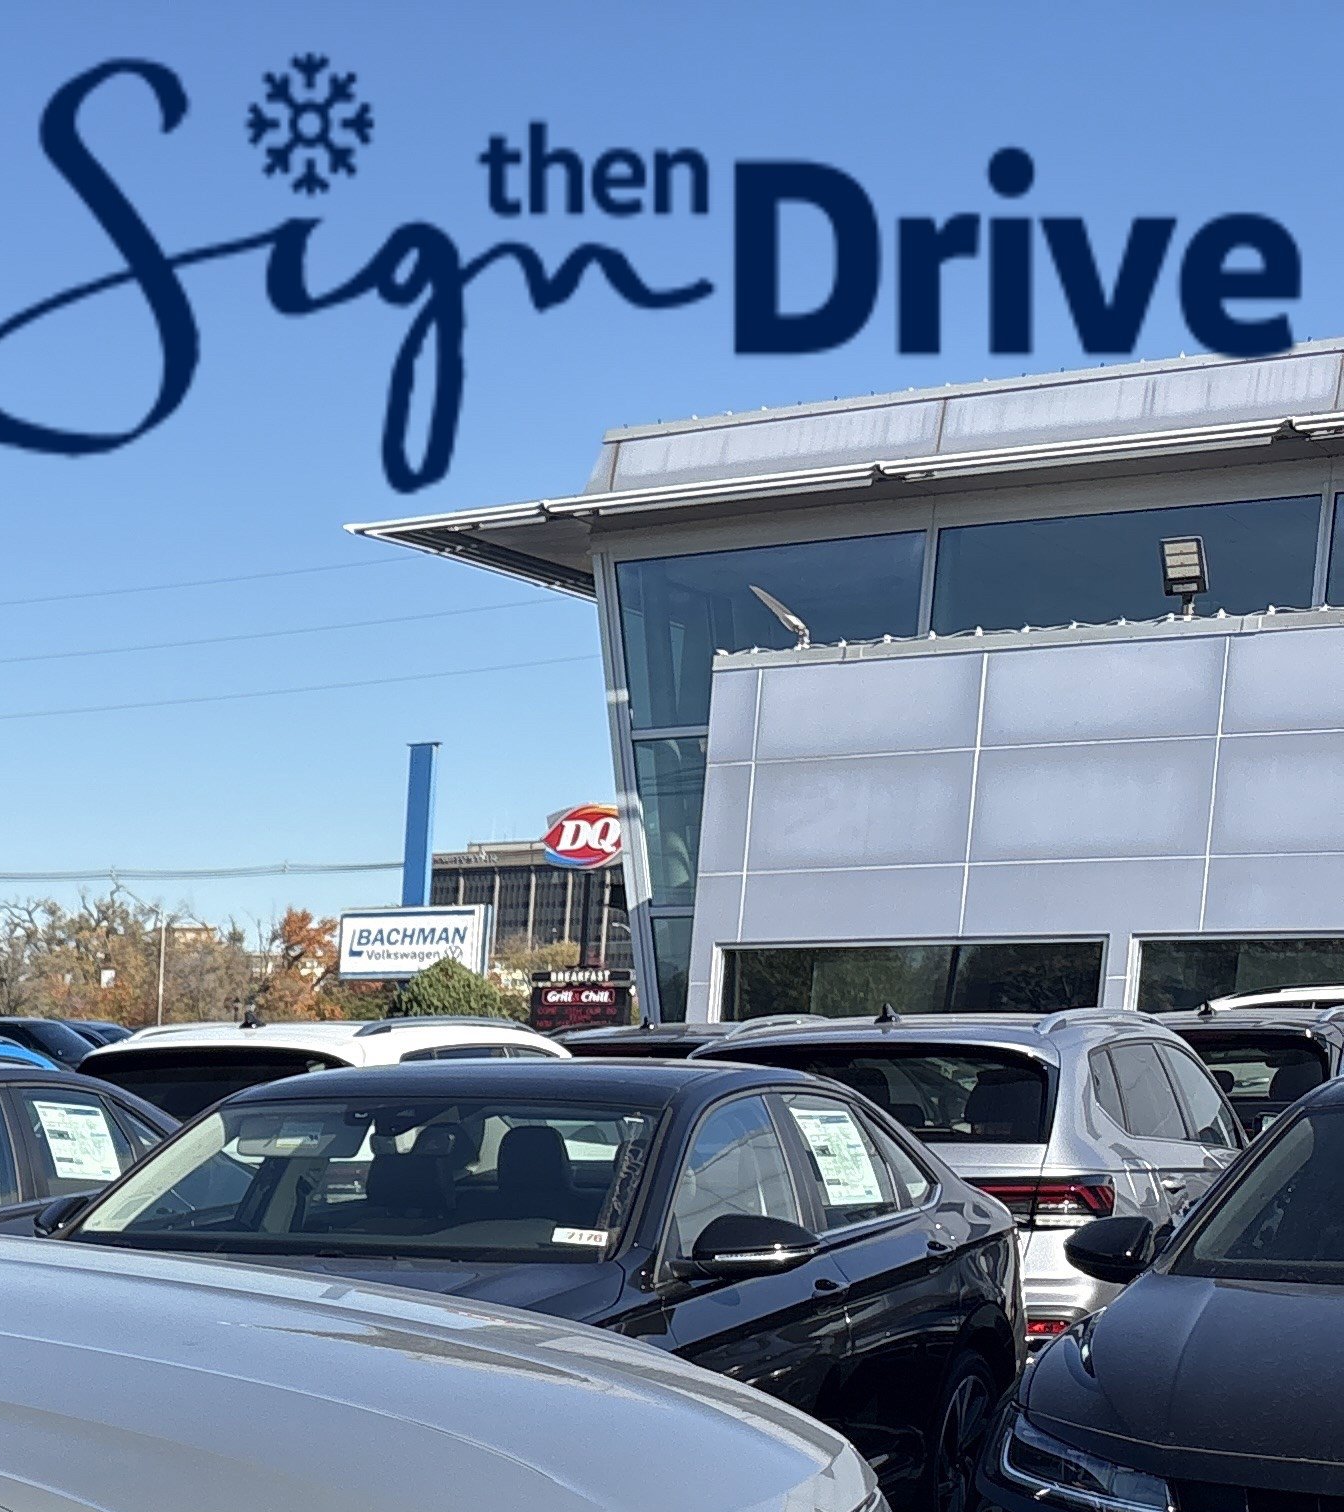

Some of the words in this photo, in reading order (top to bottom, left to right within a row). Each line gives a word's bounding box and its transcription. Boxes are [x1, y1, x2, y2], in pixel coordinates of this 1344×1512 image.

[556, 817, 621, 853] DQ
[357, 926, 468, 946] BACHMAN
[366, 949, 440, 962] Volkswagen
[550, 970, 610, 982] BREAKFAST
